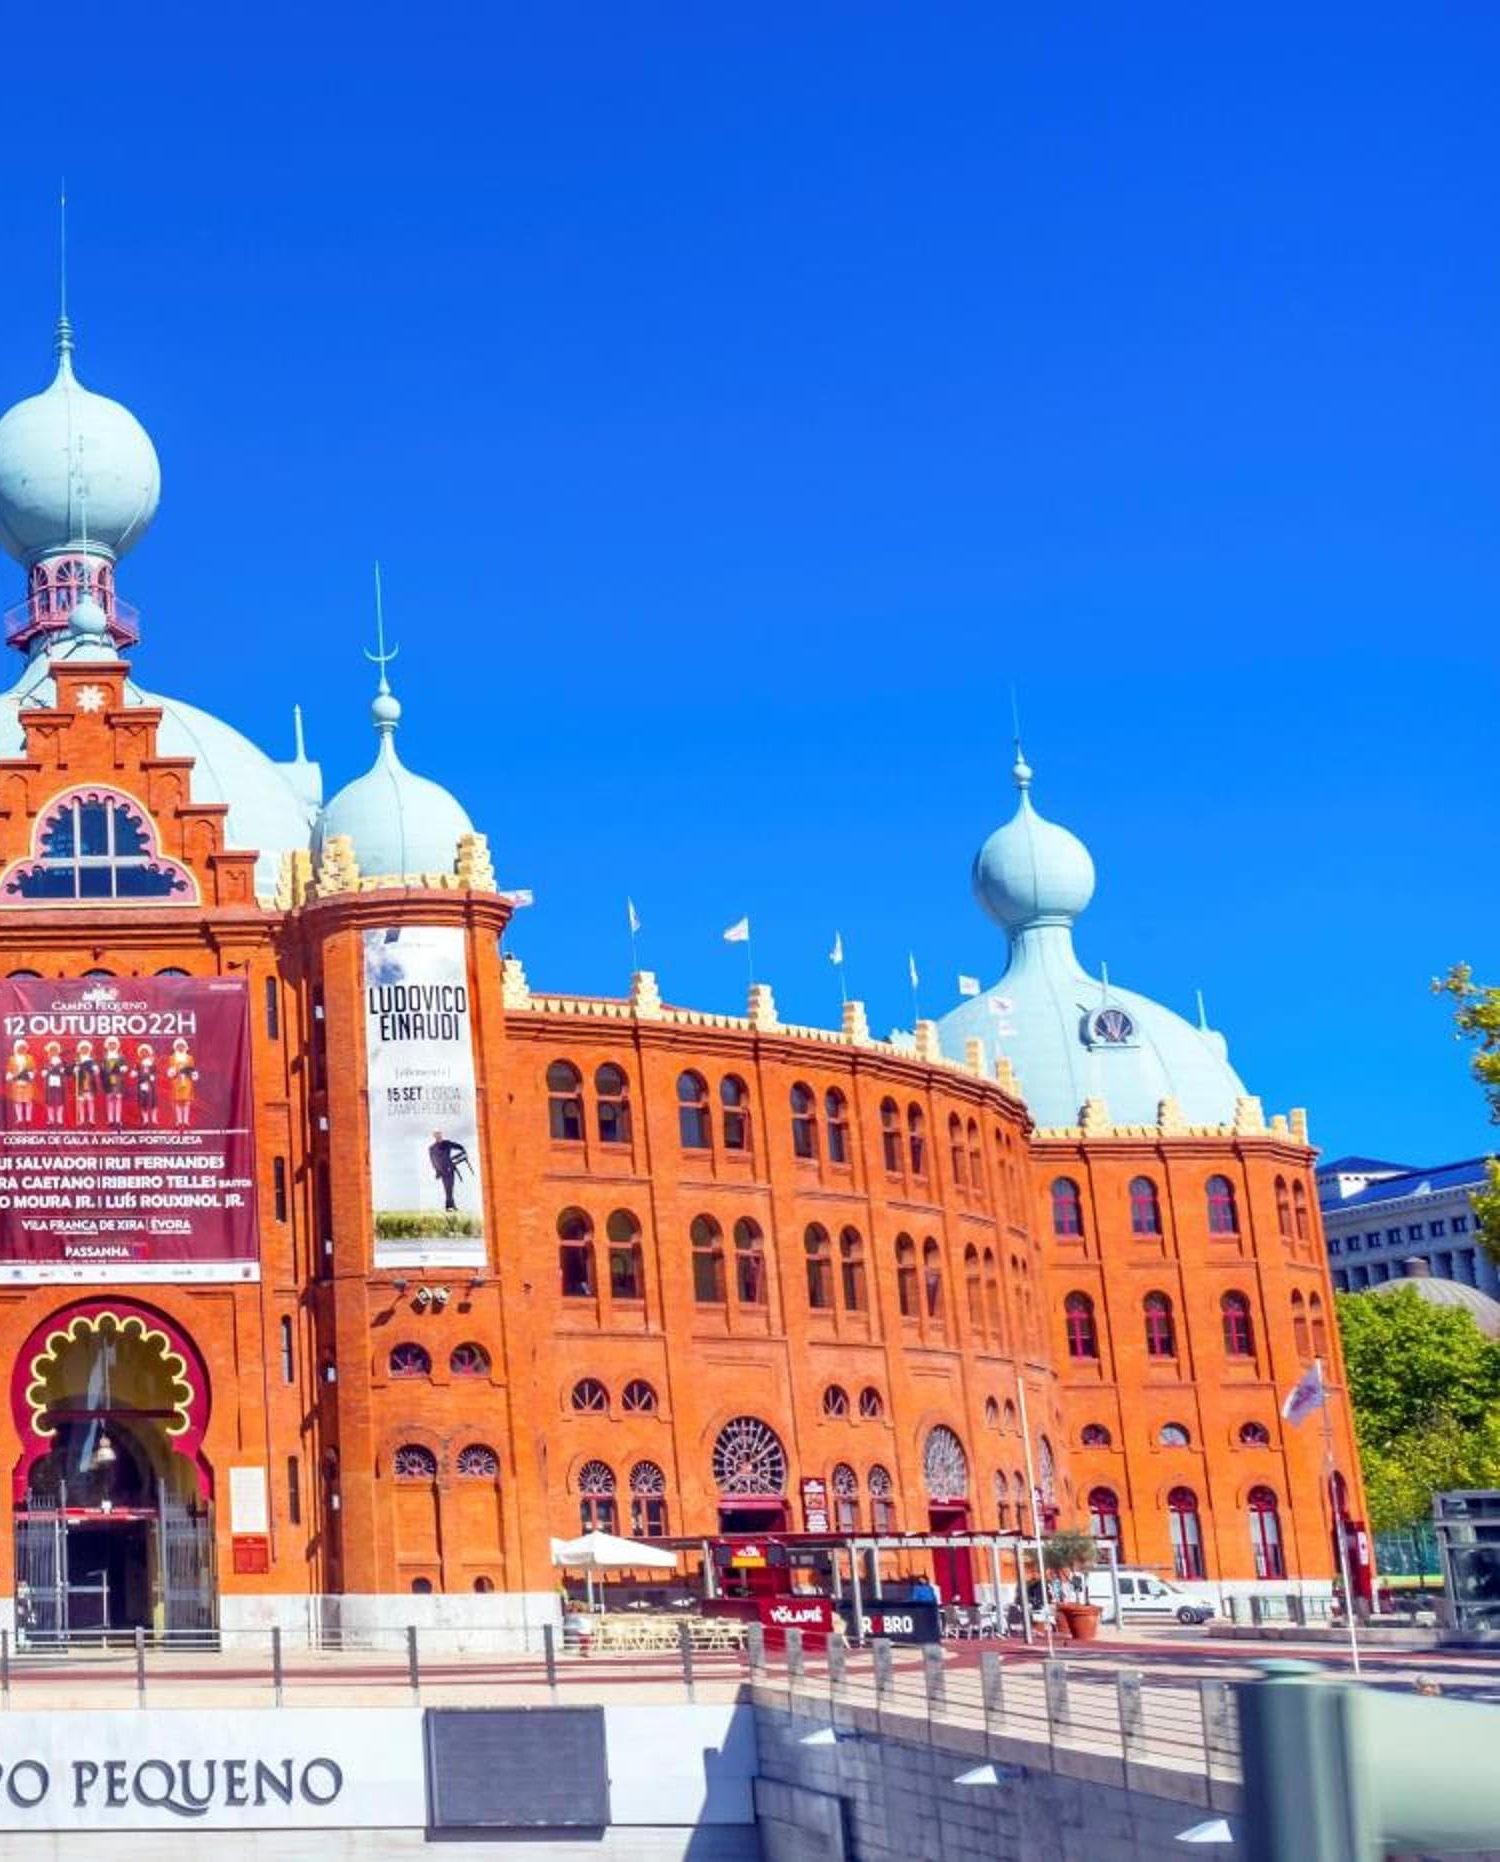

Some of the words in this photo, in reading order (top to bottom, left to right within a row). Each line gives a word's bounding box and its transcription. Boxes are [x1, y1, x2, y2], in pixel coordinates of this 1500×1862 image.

[369, 985, 466, 1014] LUDOVICO
[4, 1016, 25, 1035] 12
[29, 1015, 147, 1035] OUTUBRO
[149, 1011, 196, 1035] 22H
[380, 1013, 459, 1041] EINAUDI
[387, 1087, 400, 1102] 15
[403, 1086, 422, 1101] SET
[48, 1136, 60, 1145] DE
[63, 1136, 90, 1145] GALA
[140, 1135, 202, 1144] PORTUGUESA
[15, 1157, 97, 1169] SALVADOR
[105, 1157, 131, 1169] RUI
[134, 1156, 225, 1169] FERNANDES
[22, 1176, 95, 1189] CAETANO
[102, 1176, 163, 1189] RIBEIRO
[166, 1175, 217, 1189] TELLES
[13, 1195, 71, 1208] MOURA
[75, 1195, 95, 1210] JR.
[105, 1192, 136, 1208] LUÍS
[140, 1194, 222, 1208] ROUXINOL
[21, 1220, 48, 1231] VILA
[100, 1220, 115, 1231] DE
[117, 1219, 145, 1231] XIRA
[150, 1217, 191, 1231] ÉVORA
[65, 1246, 130, 1257] PASSANHA
[71, 1757, 343, 1817] PEQUENO
